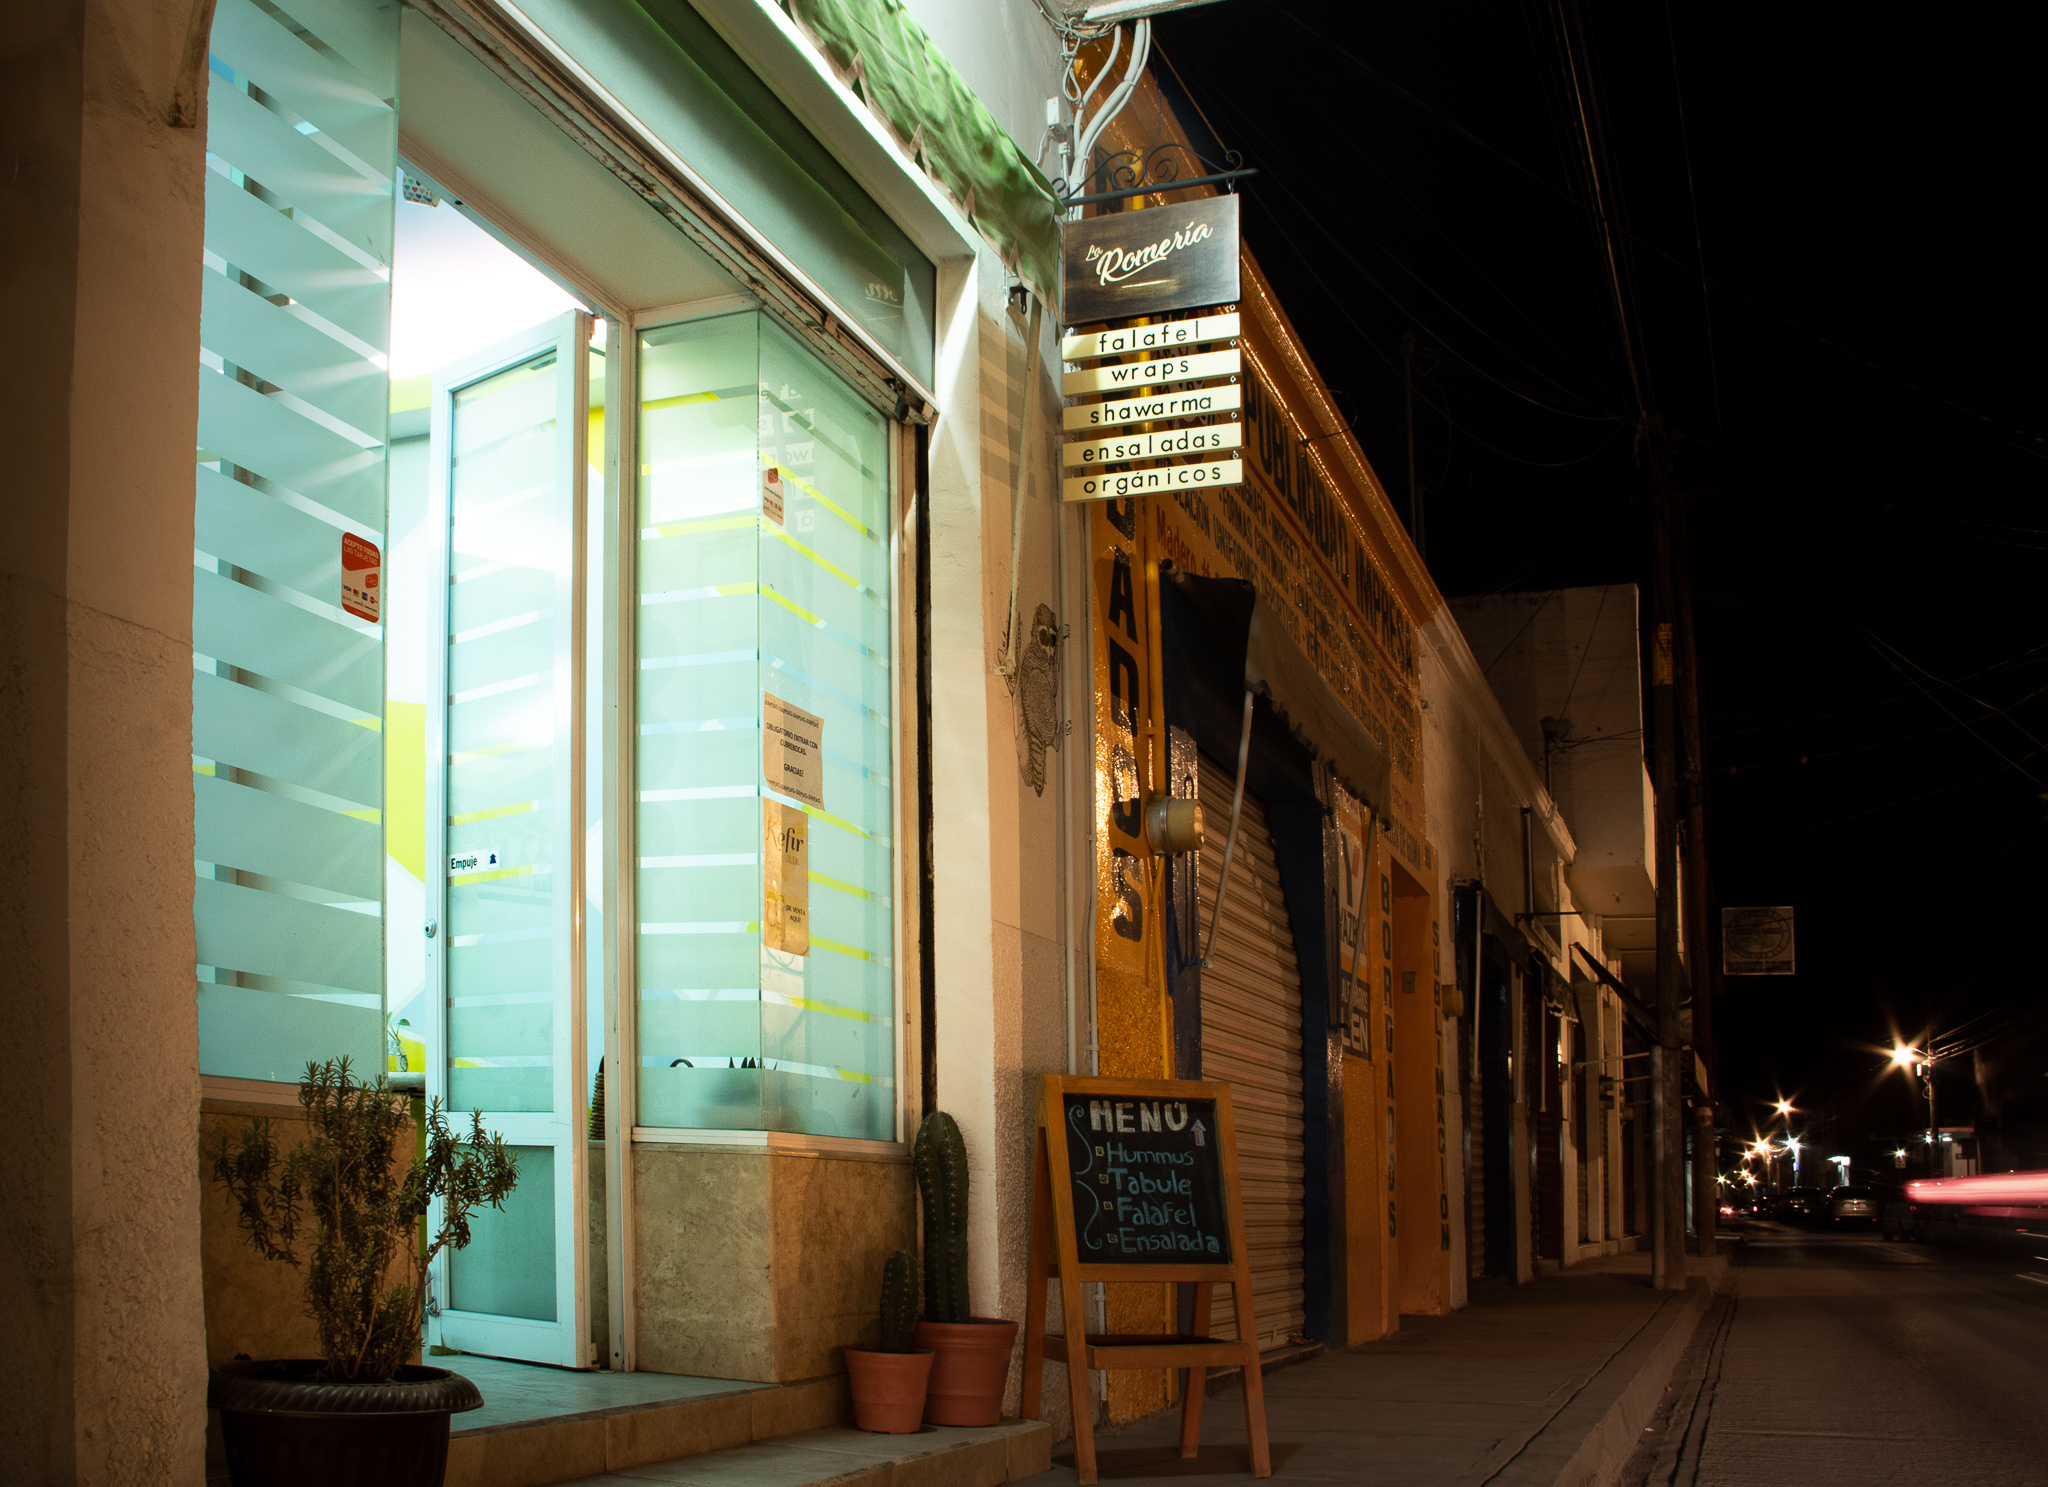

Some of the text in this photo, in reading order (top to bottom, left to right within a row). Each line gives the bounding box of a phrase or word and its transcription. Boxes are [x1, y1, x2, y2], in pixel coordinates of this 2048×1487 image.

[1096, 220, 1214, 287] Romería
[1099, 320, 1200, 353] falafel
[1111, 358, 1190, 383] wraps
[1089, 394, 1213, 424] shawarma
[1082, 430, 1222, 463] ensaladas
[1082, 462, 1222, 496] orgánicos
[1221, 484, 1252, 550] FORMAS
[1156, 503, 1197, 576] Madero
[766, 722, 793, 740] OBLIGATORIO
[793, 731, 809, 747] ENTRAR
[766, 818, 804, 852] Kefir
[450, 855, 478, 871] Empuje
[1432, 920, 1450, 1252] SUBLIMACION
[1106, 1141, 1195, 1166] Hummus
[1107, 1167, 1193, 1196] Tabule
[1116, 1196, 1198, 1228] Falafel
[1118, 1227, 1220, 1254] Ensalada
